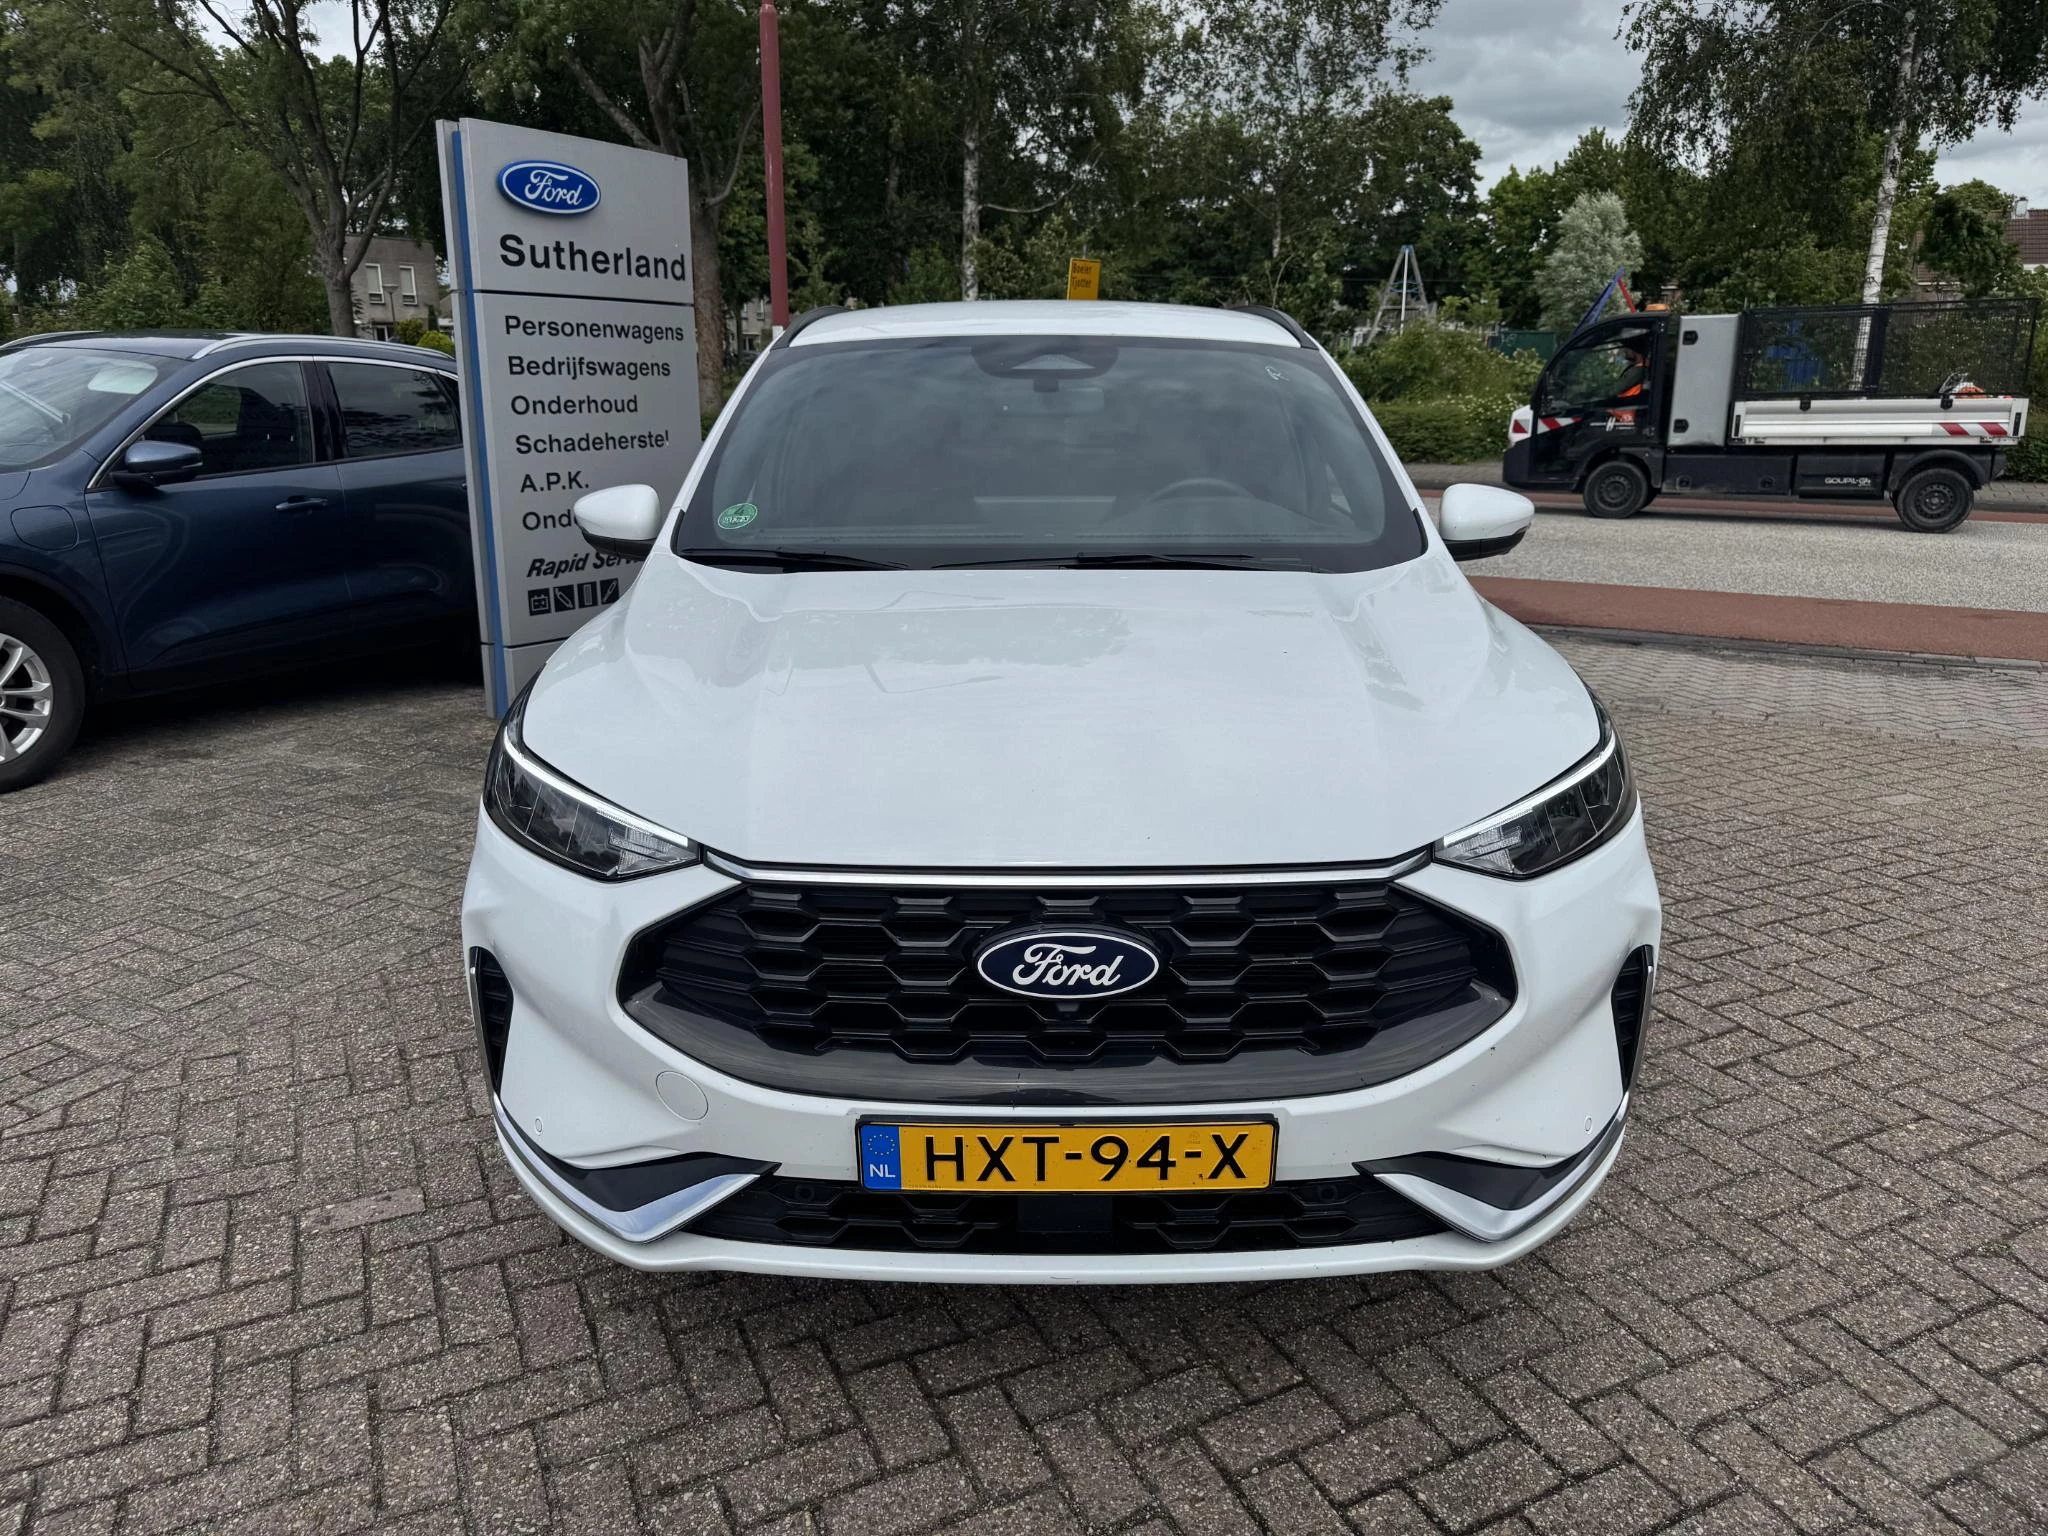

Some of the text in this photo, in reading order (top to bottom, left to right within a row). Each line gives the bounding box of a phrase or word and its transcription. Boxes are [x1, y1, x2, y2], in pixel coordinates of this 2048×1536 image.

[524, 169, 583, 206] Ford
[499, 234, 686, 281] Sutherland
[504, 315, 685, 344] Personenwagens
[507, 356, 672, 380] Bedrijfswagens
[510, 395, 639, 416] Onderhoud
[515, 429, 669, 454] Schadeherstel
[520, 471, 590, 493] A.P.K.
[522, 508, 578, 531] Ond
[526, 552, 590, 579] Rapid
[1011, 942, 1125, 987] Ford
[869, 1132, 1250, 1183] NL HXT-94-X
